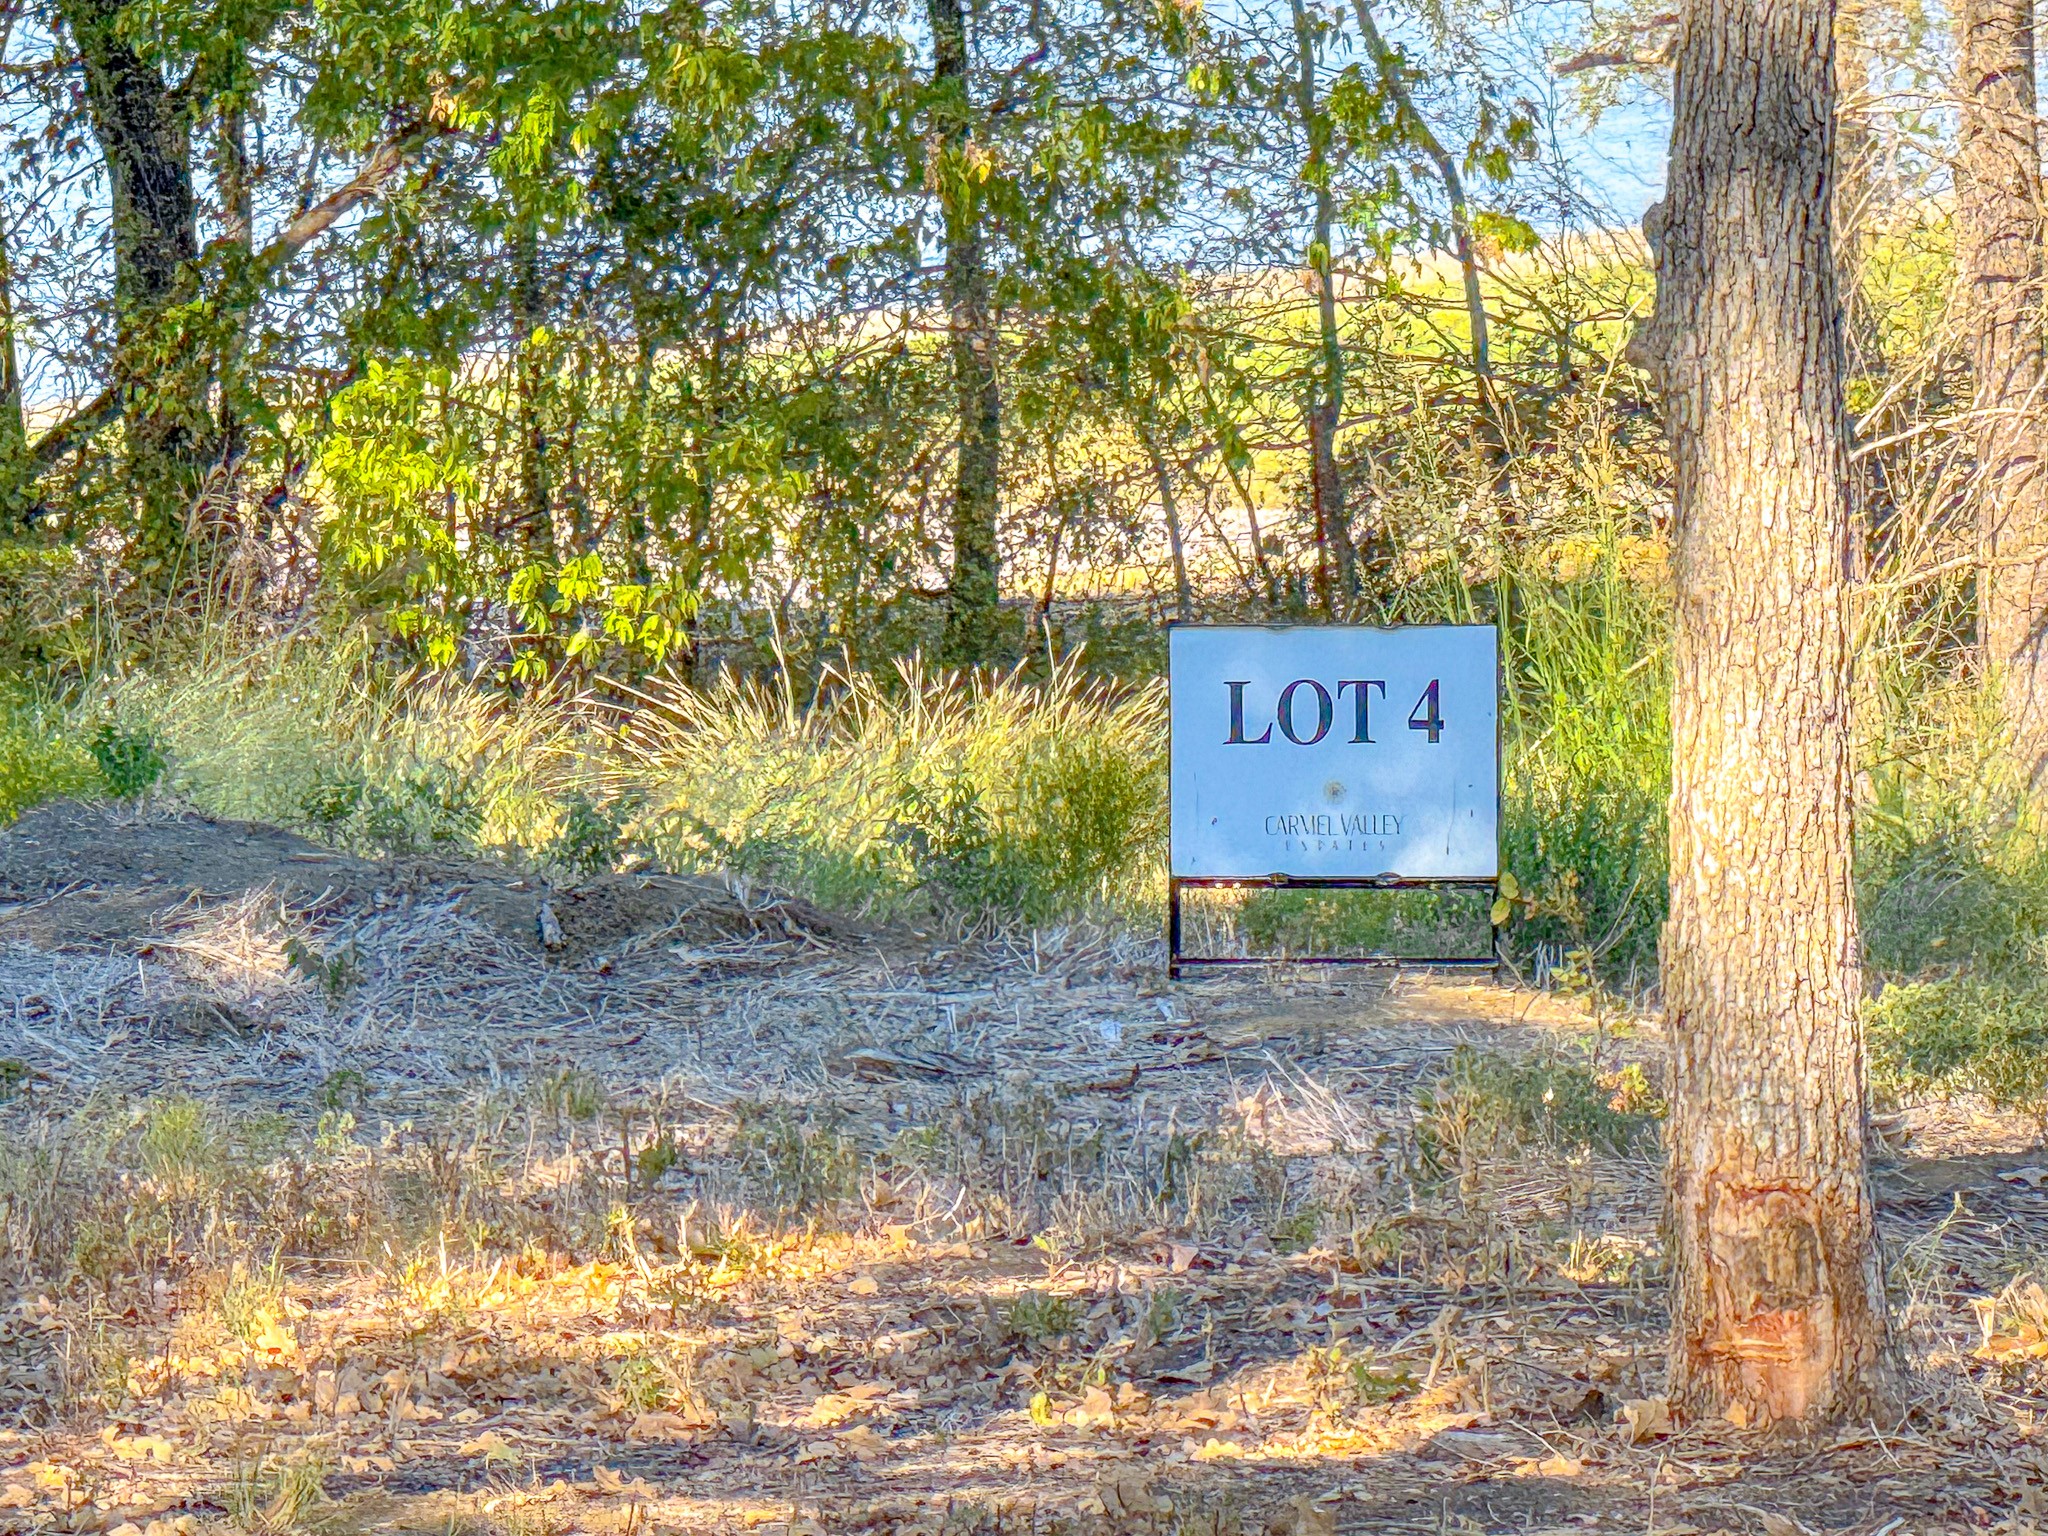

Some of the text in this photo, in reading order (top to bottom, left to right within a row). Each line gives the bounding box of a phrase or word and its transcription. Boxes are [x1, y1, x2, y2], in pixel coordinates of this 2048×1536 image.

[1223, 679, 1444, 745] LOT 4
[1265, 814, 1405, 836] CARMEL VALLEY
